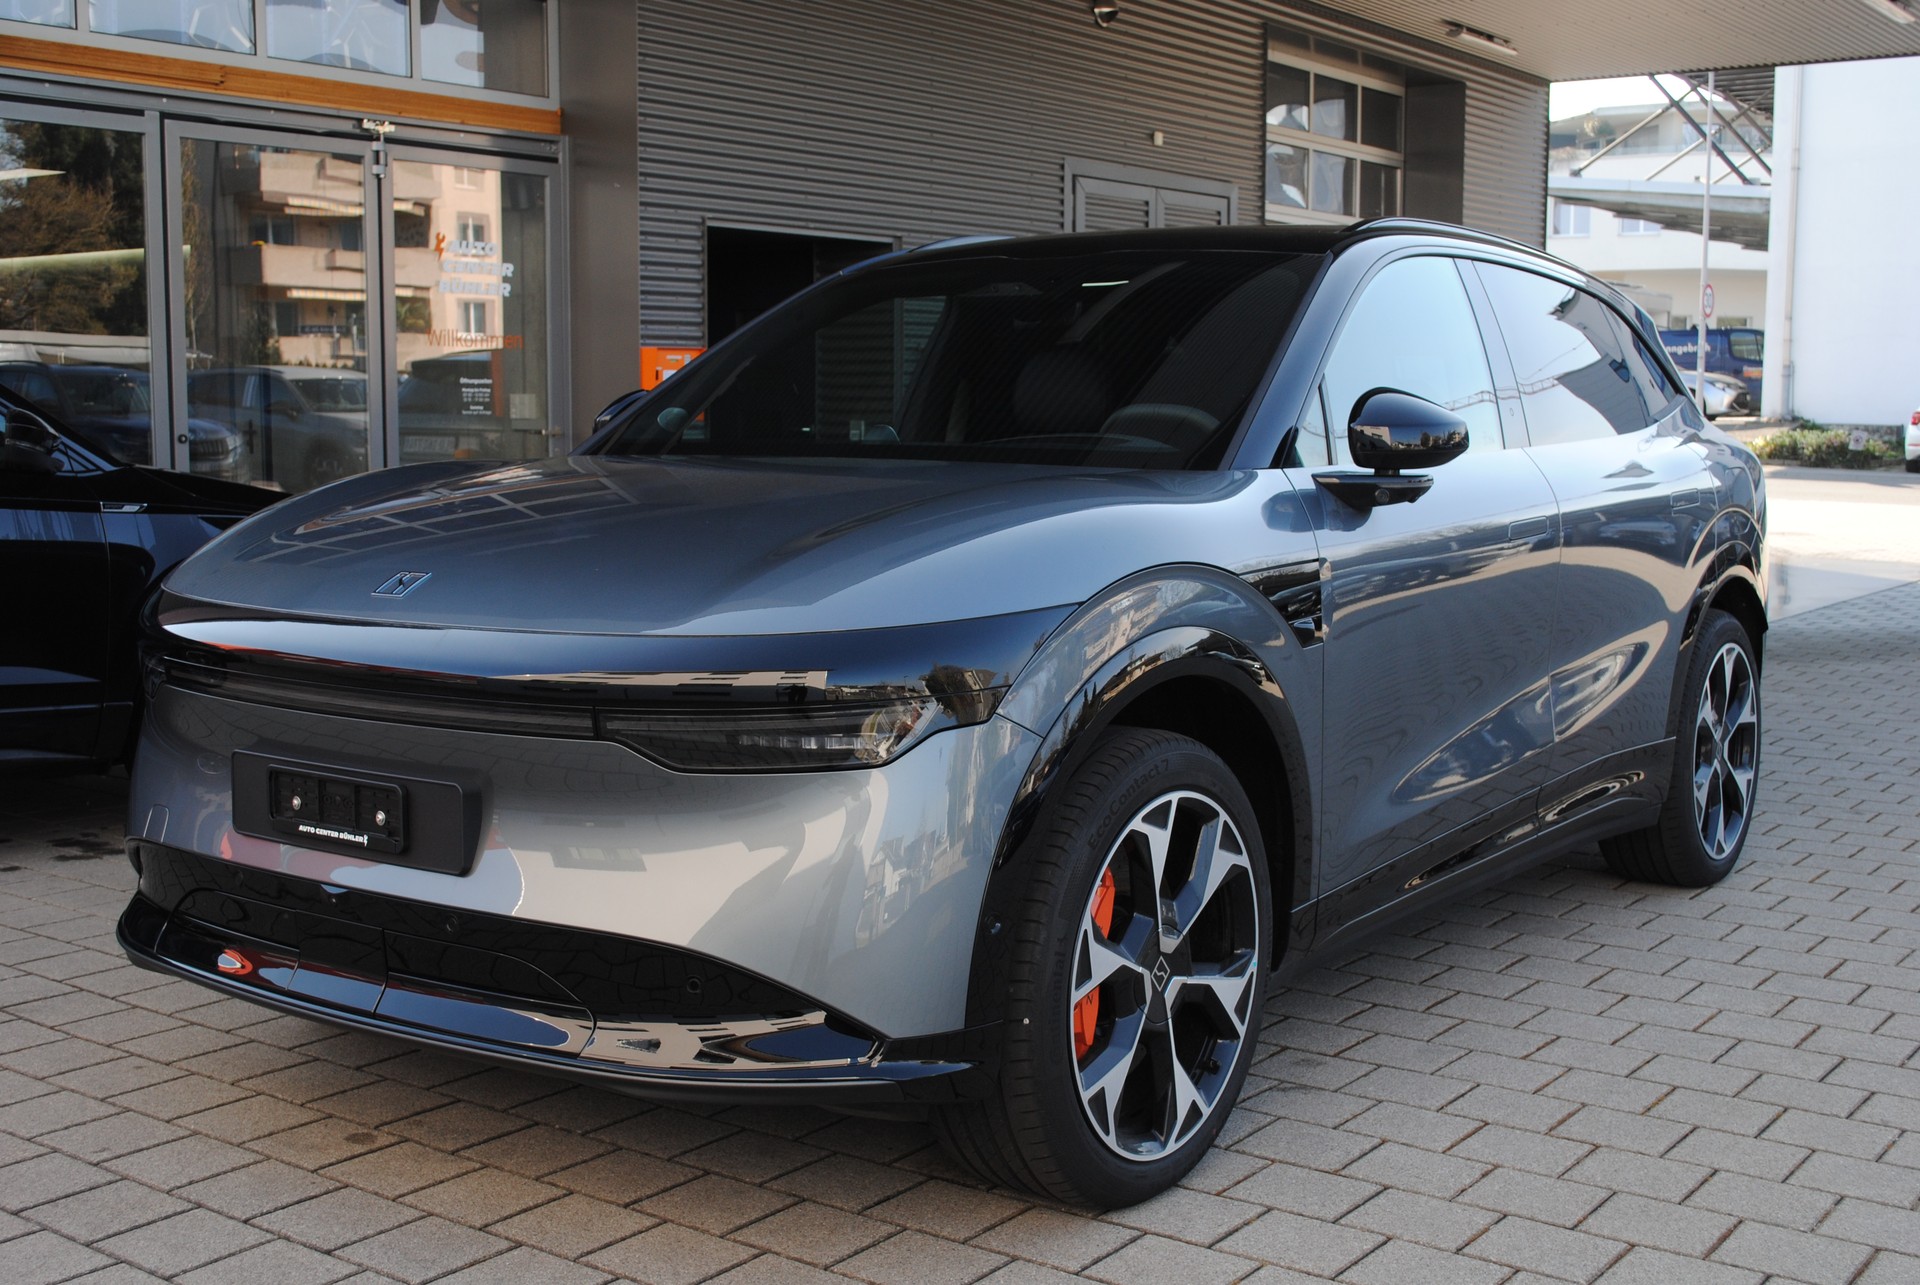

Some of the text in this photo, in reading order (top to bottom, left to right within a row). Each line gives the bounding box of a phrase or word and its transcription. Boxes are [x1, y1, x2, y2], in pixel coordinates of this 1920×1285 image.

[449, 240, 498, 256] AUTO
[443, 260, 515, 277] CENTER
[438, 278, 512, 297] BÜHLER
[1704, 292, 1712, 309] 30
[427, 328, 523, 349] Willkommen
[1087, 758, 1169, 850] EcoContact 7
[298, 825, 364, 843] AUTO CENTER BÜHLER
